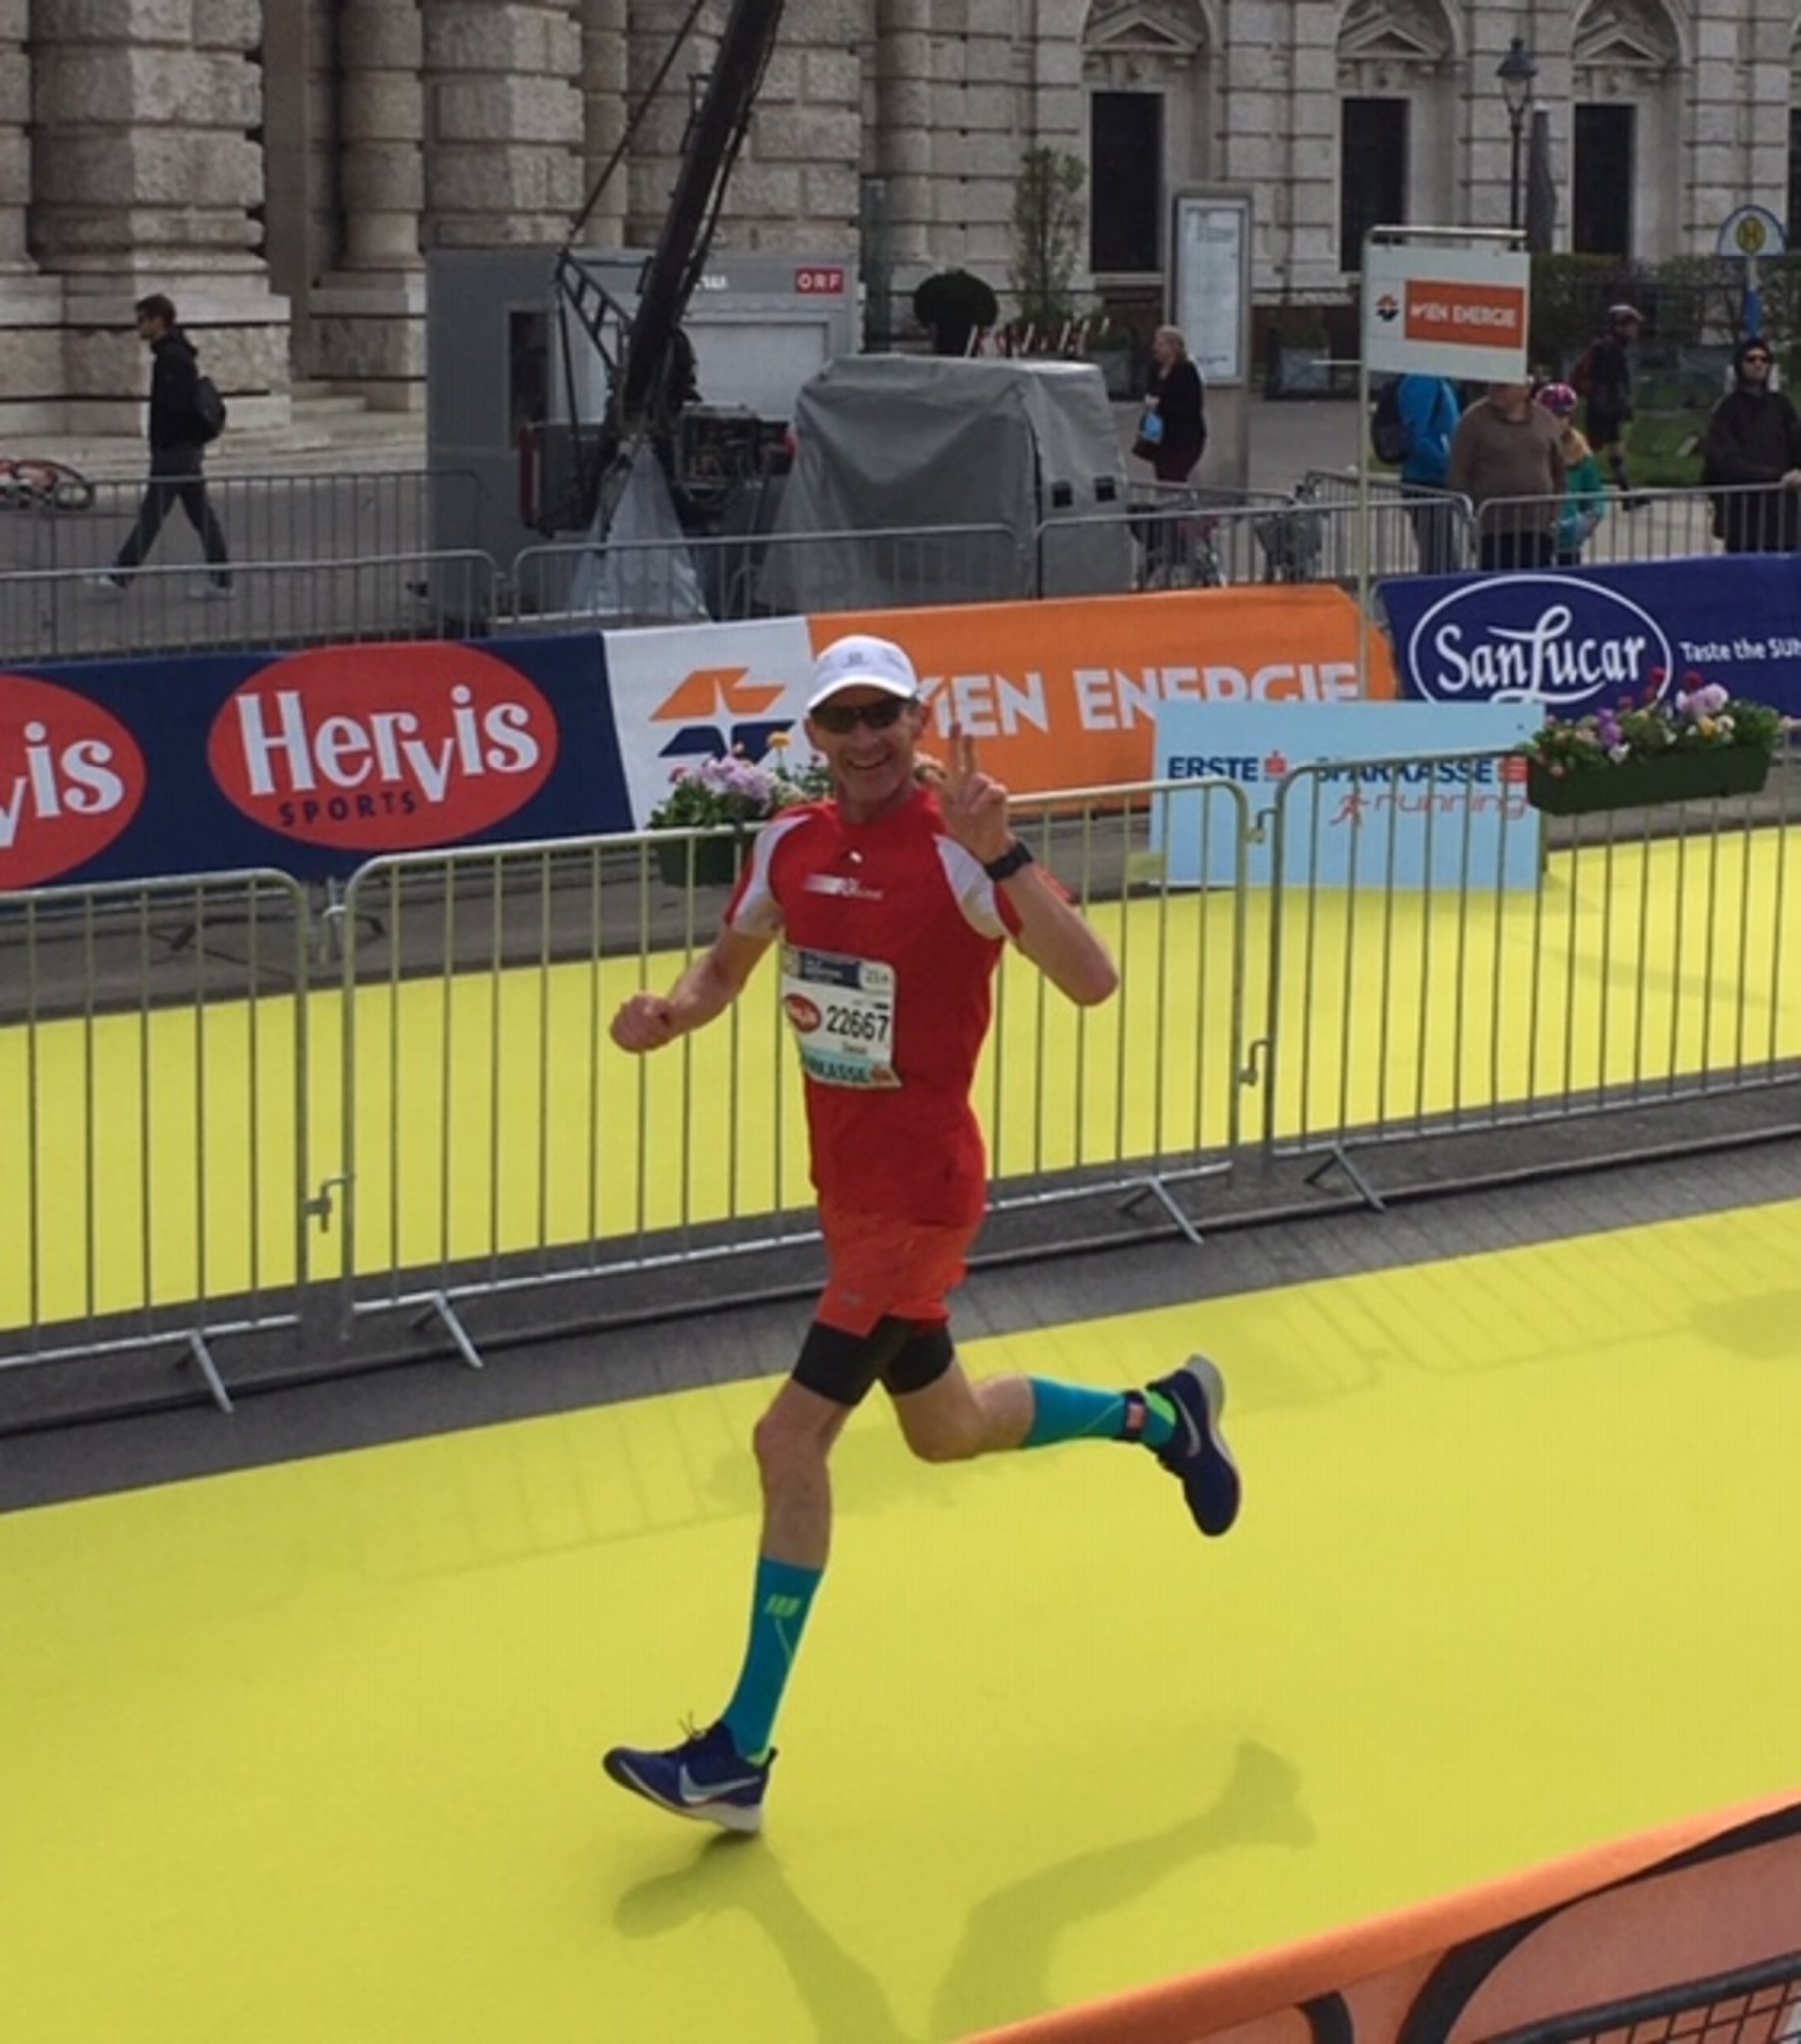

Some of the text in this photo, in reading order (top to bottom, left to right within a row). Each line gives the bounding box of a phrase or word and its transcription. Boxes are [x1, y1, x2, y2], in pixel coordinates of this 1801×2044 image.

[797, 272, 841, 290] ORF
[1410, 303, 1447, 323] WIEN
[1435, 605, 1646, 703] SanLucar
[1679, 641, 1731, 662] Taste
[1733, 638, 1766, 660] the
[236, 684, 540, 802] Hervis
[1168, 756, 1259, 782] ERSTE
[279, 791, 417, 827] SPORTS
[826, 1004, 889, 1042] 22667
